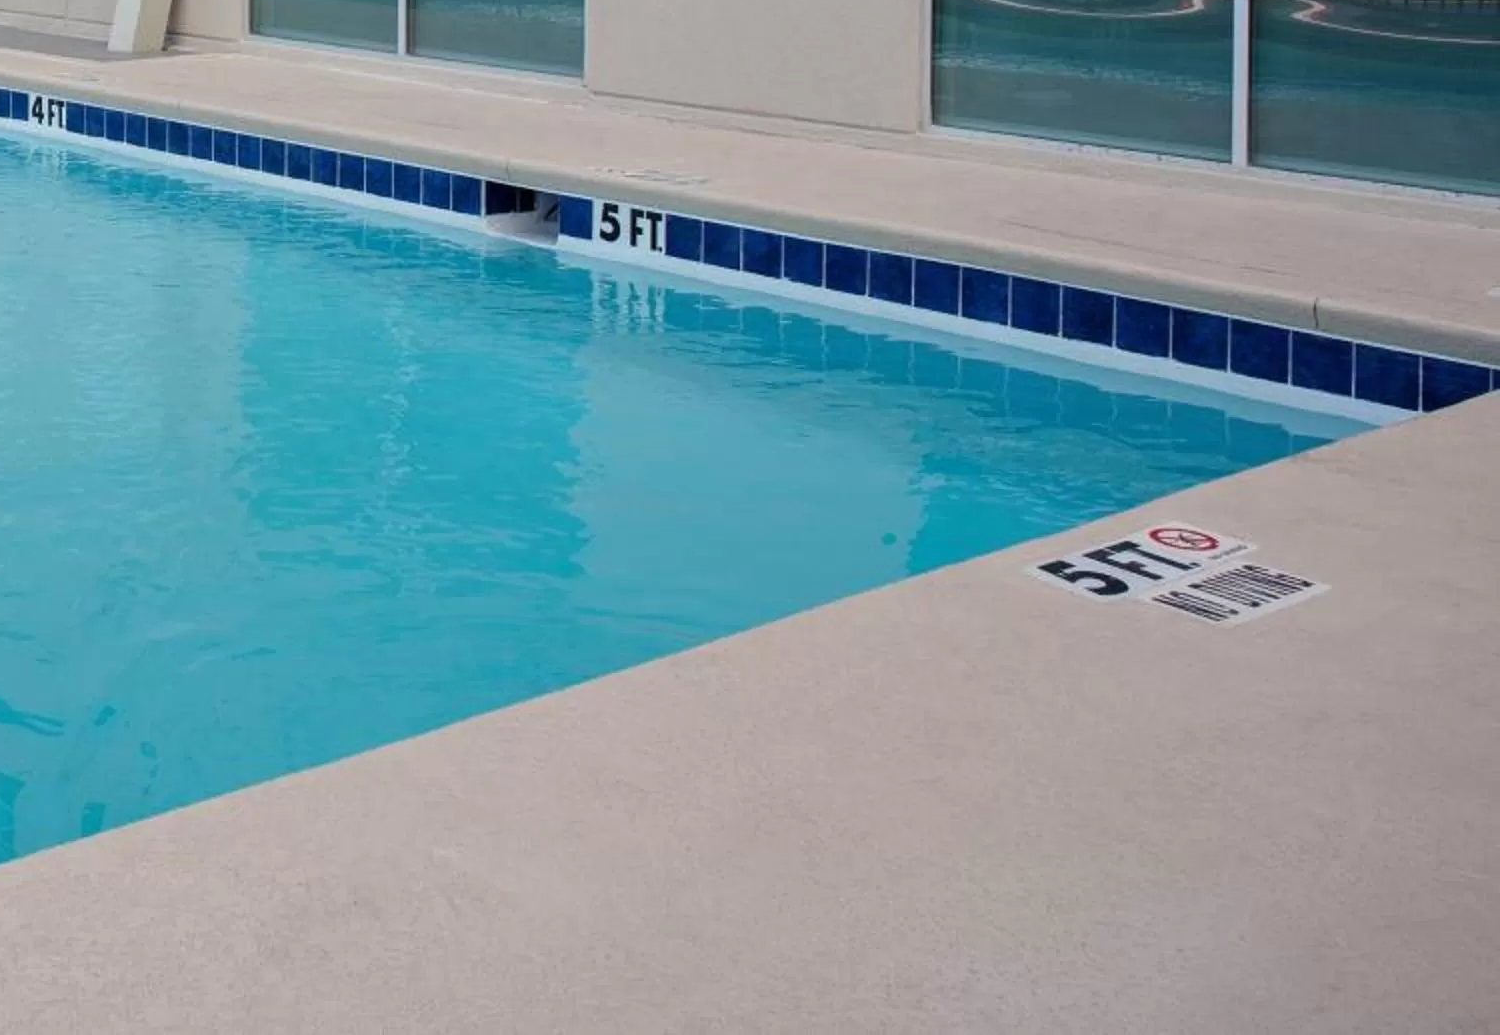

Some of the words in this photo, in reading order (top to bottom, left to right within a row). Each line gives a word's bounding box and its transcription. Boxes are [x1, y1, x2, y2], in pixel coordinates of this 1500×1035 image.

[31, 96, 45, 126] 4
[47, 98, 65, 129] FT
[599, 202, 621, 243] 5
[1037, 560, 1130, 596] 5
[1187, 564, 1316, 608] DIVING
[1151, 590, 1240, 622] NO
